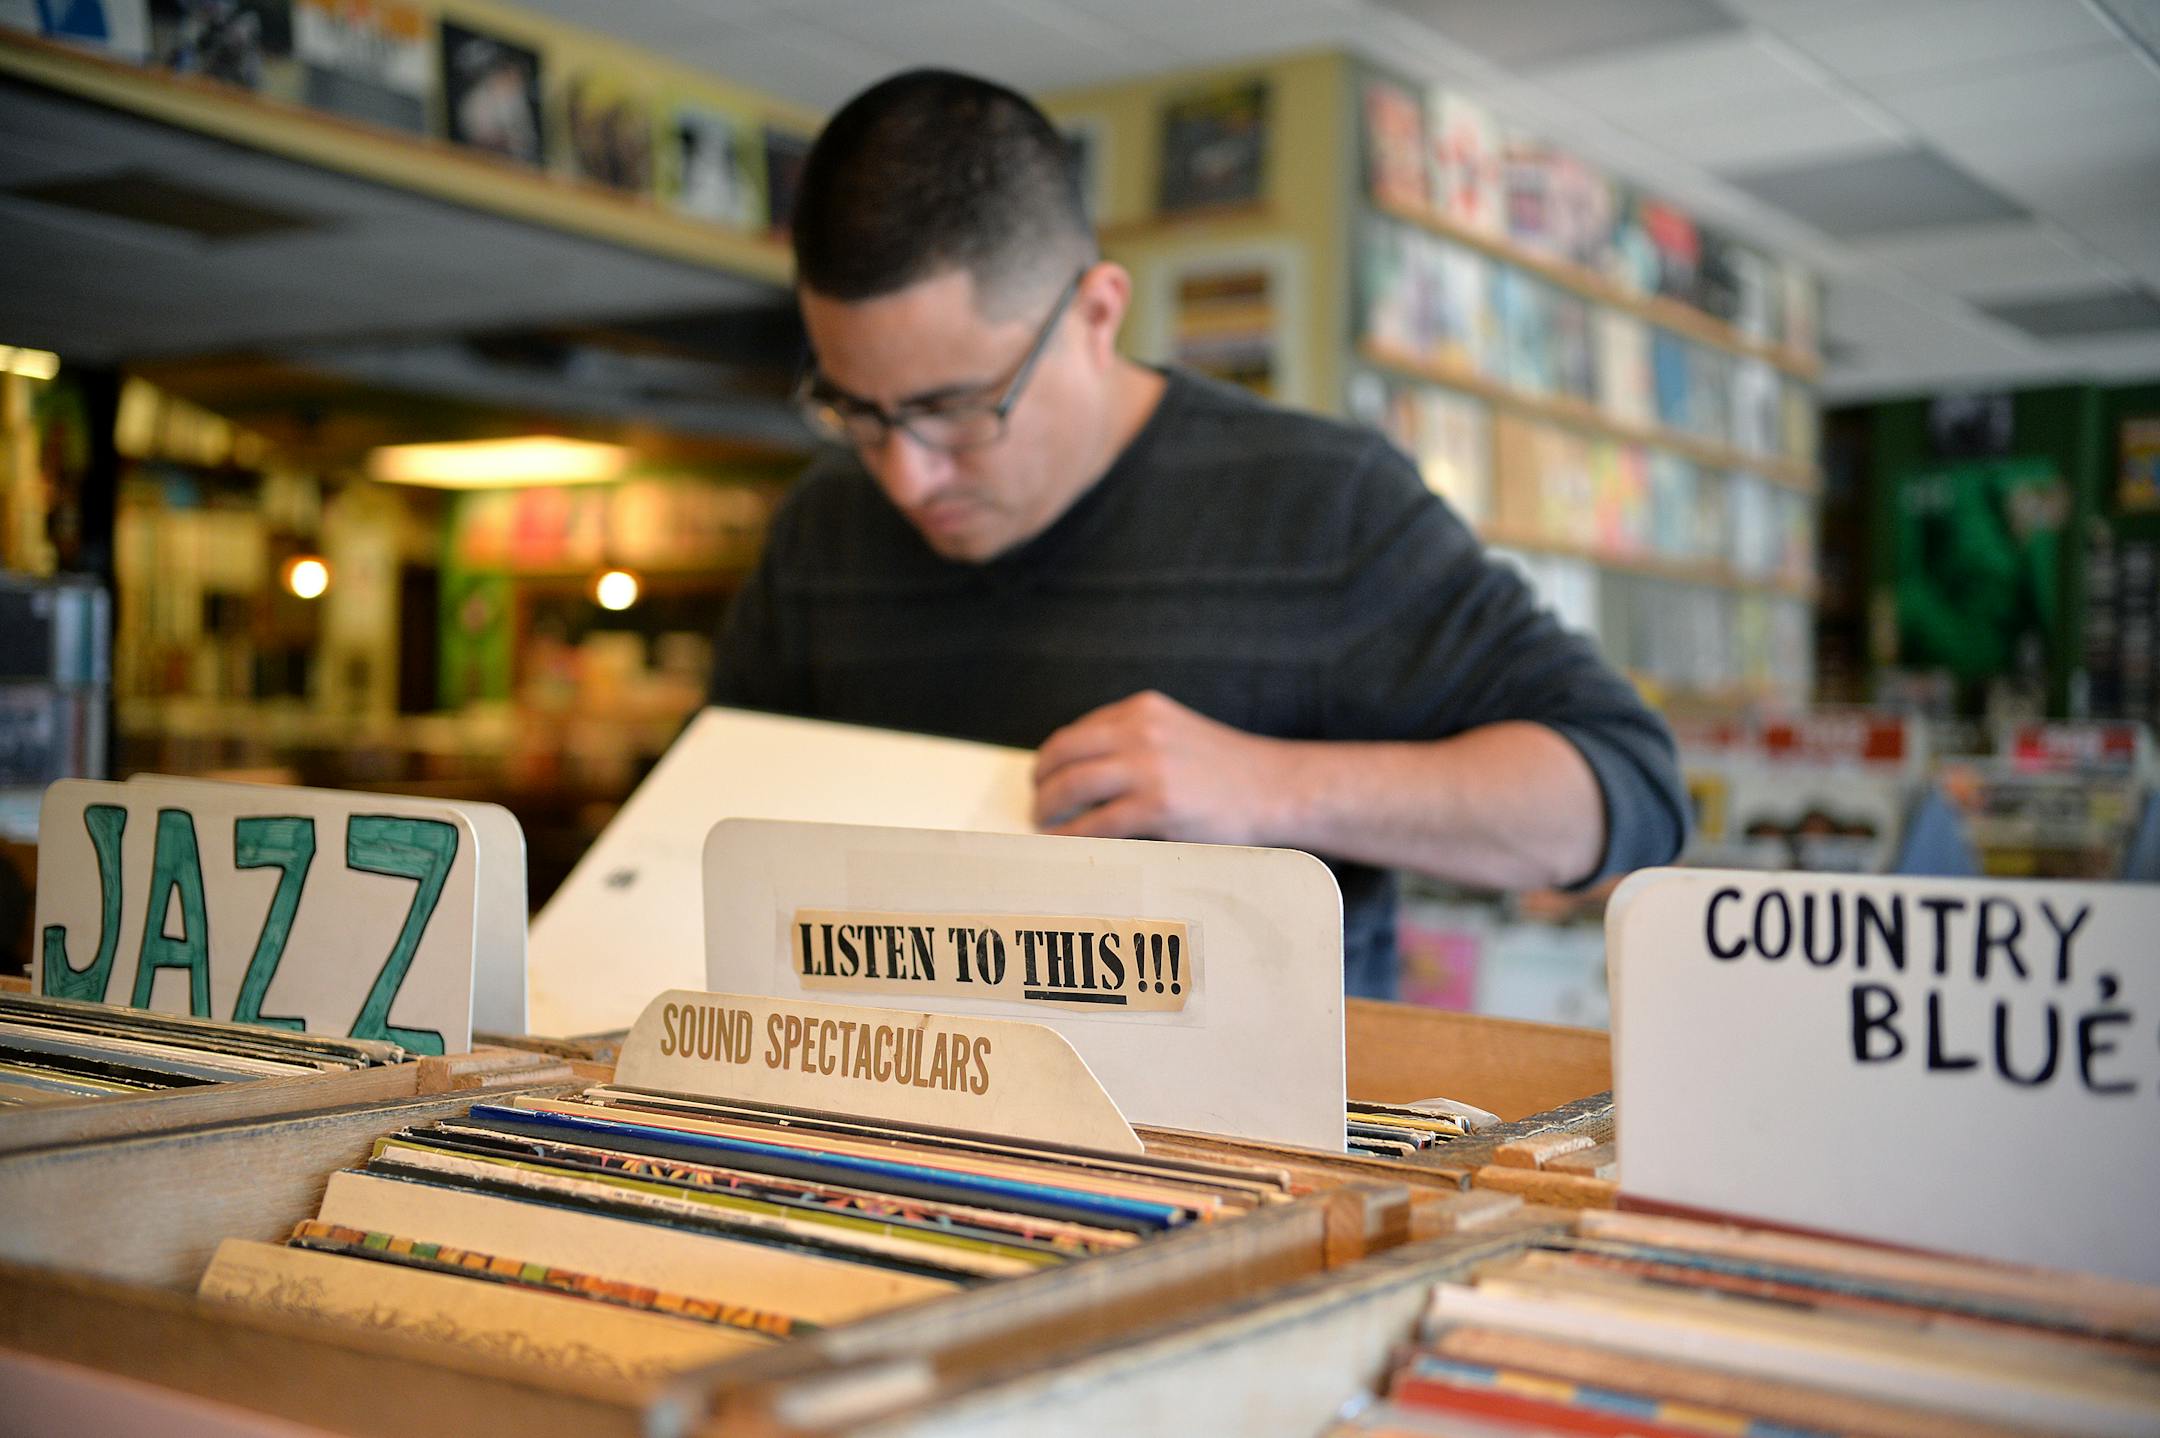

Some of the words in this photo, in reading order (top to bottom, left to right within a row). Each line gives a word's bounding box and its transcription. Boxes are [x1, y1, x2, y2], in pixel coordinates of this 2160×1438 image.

[42, 804, 459, 1056] JAZZ
[798, 922, 936, 981] LISTEN
[947, 926, 1006, 986] TO
[1705, 886, 2118, 1002] COUNTRY,
[660, 1002, 753, 1065] SOUND
[764, 1012, 992, 1096] SPECTACULARS
[1850, 984, 2160, 1096] BLUE
